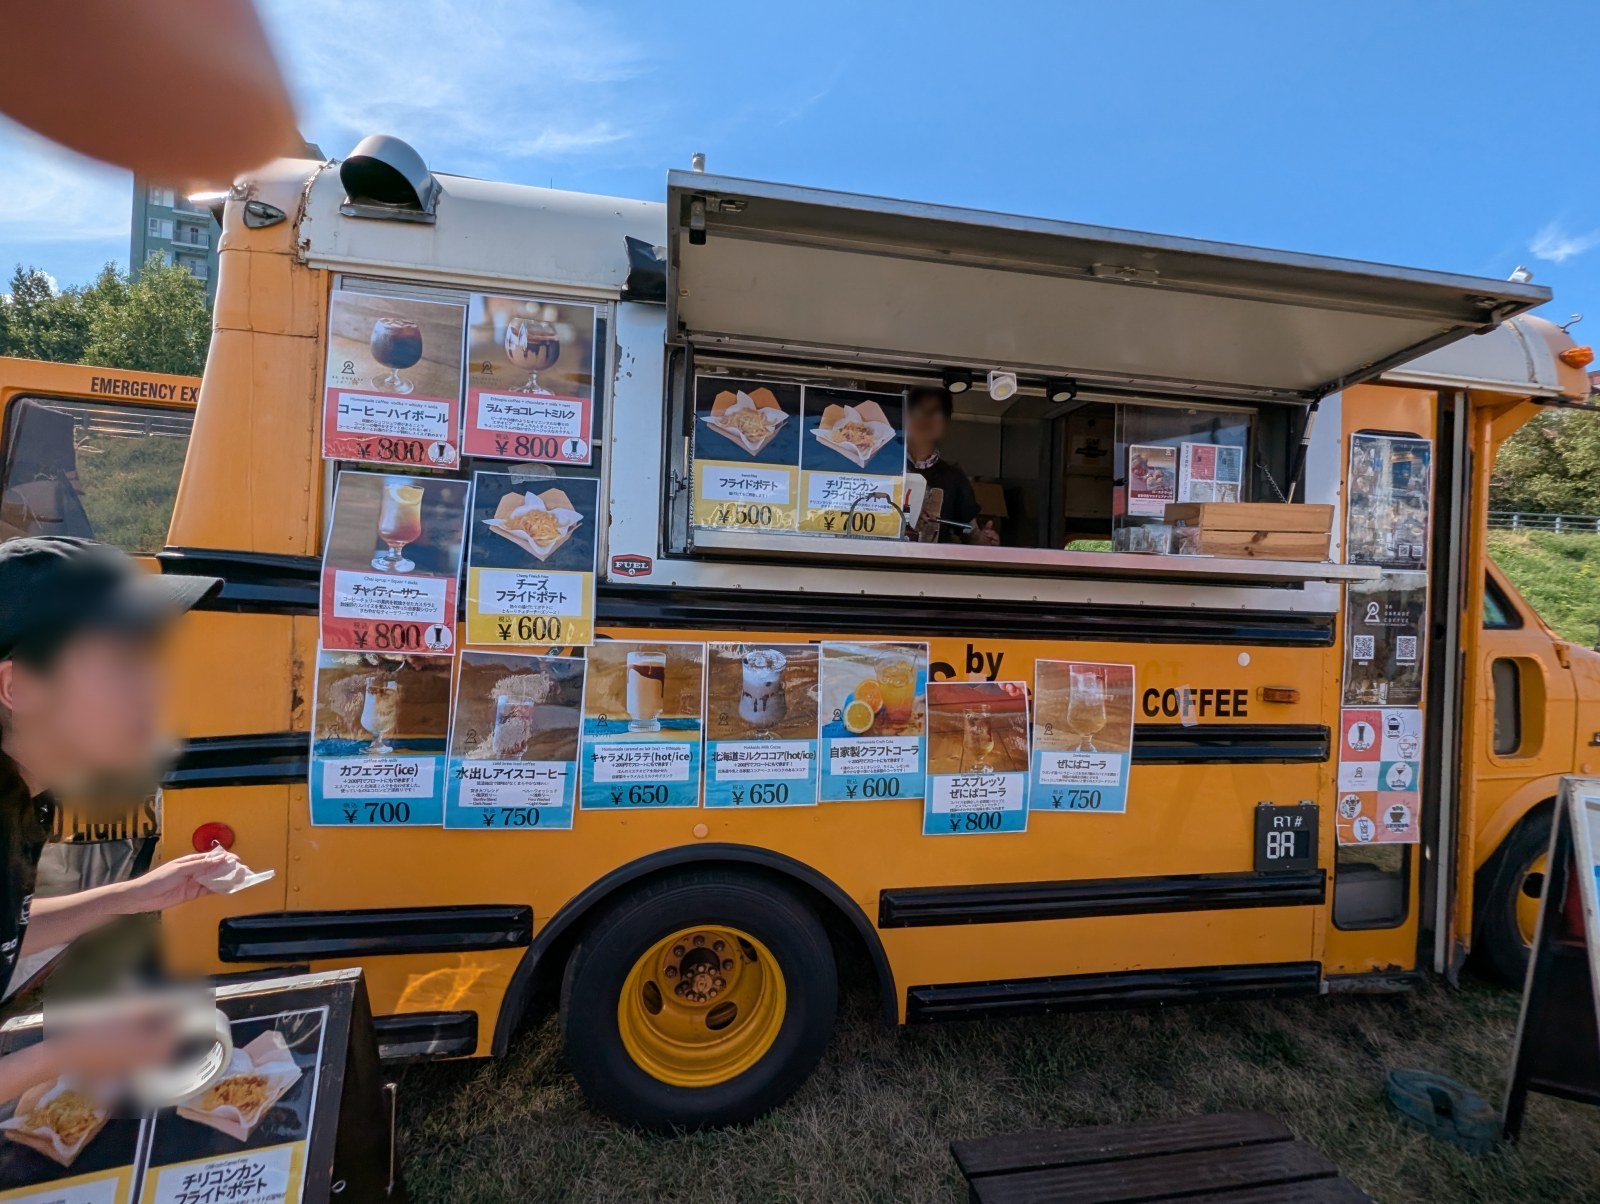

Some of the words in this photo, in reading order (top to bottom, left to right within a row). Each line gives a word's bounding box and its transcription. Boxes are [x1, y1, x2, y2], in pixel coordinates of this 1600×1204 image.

[91, 377, 176, 399] EMERGENCY
[338, 404, 448, 424] コーヒーハイボール
[486, 403, 502, 413] ラム
[504, 406, 576, 420] チョコレートミルク
[378, 438, 424, 462] 800
[514, 436, 558, 458] 800
[720, 478, 778, 491] フライドポテト
[826, 480, 878, 492] チリコンカン
[736, 504, 772, 526] 500
[840, 512, 876, 532] 700
[352, 584, 428, 598] チャイティーサワー
[516, 578, 548, 590] チーズ
[496, 590, 567, 604] フライドポテト
[375, 623, 420, 650] 800
[518, 616, 561, 640] 600
[966, 644, 1004, 682] by
[1142, 688, 1248, 717] COFFEE
[591, 752, 693, 762] キャラメルラテ(hot/ice)
[712, 750, 816, 762] 北海道ミルクココア(hot/ice)
[830, 746, 919, 758] 自家製クラフトコーラ
[340, 764, 418, 777] カフェラテ(ice)
[456, 767, 568, 780] 水出しアイスコーヒー
[1057, 760, 1107, 770] ぜにばコーラ
[863, 777, 900, 798] 600
[951, 777, 1006, 788] エスプレッソ
[628, 784, 668, 804] 650
[750, 783, 788, 804] 650
[950, 788, 1006, 798] ぜにばコーラ
[1068, 790, 1102, 809] 750
[364, 802, 410, 823] 700
[501, 808, 540, 826] 750
[966, 812, 1002, 830] 800
[1274, 816, 1302, 828] RT#
[1266, 832, 1294, 859] 8A
[182, 1163, 266, 1191] チリコンカン
[175, 1178, 268, 1204] フライドポテト
